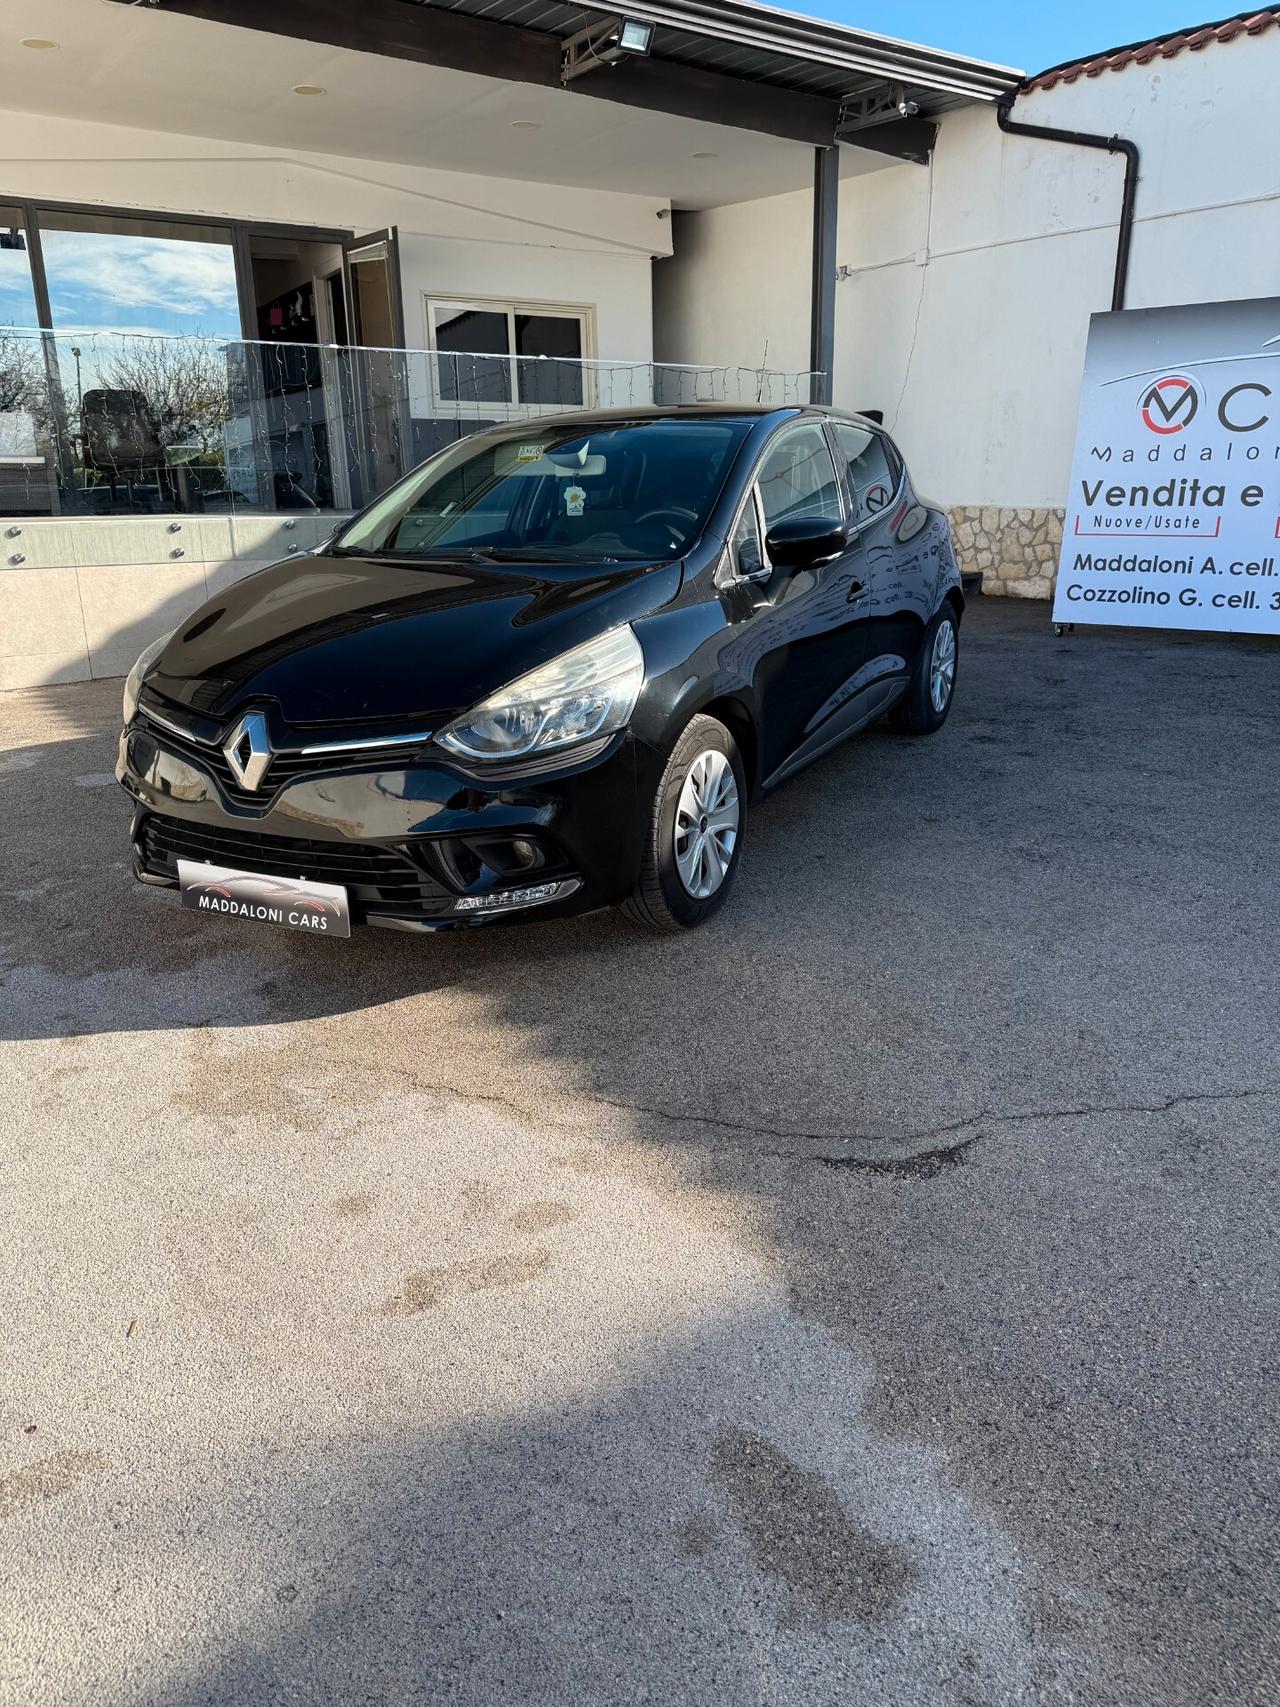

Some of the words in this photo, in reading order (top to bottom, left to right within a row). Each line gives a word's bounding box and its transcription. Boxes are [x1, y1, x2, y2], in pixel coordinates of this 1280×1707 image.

[1081, 478, 1226, 507] Vendita
[1240, 485, 1264, 507] e
[1093, 515, 1200, 530] Nuove/Usate
[1073, 553, 1194, 574] Maddaloni
[1229, 557, 1279, 577] cell.
[1066, 583, 1171, 605] Cozzolino
[1178, 588, 1203, 607] G.
[1211, 590, 1260, 610] cell.
[198, 895, 283, 923] MADDALONI
[288, 912, 328, 930] CARS
